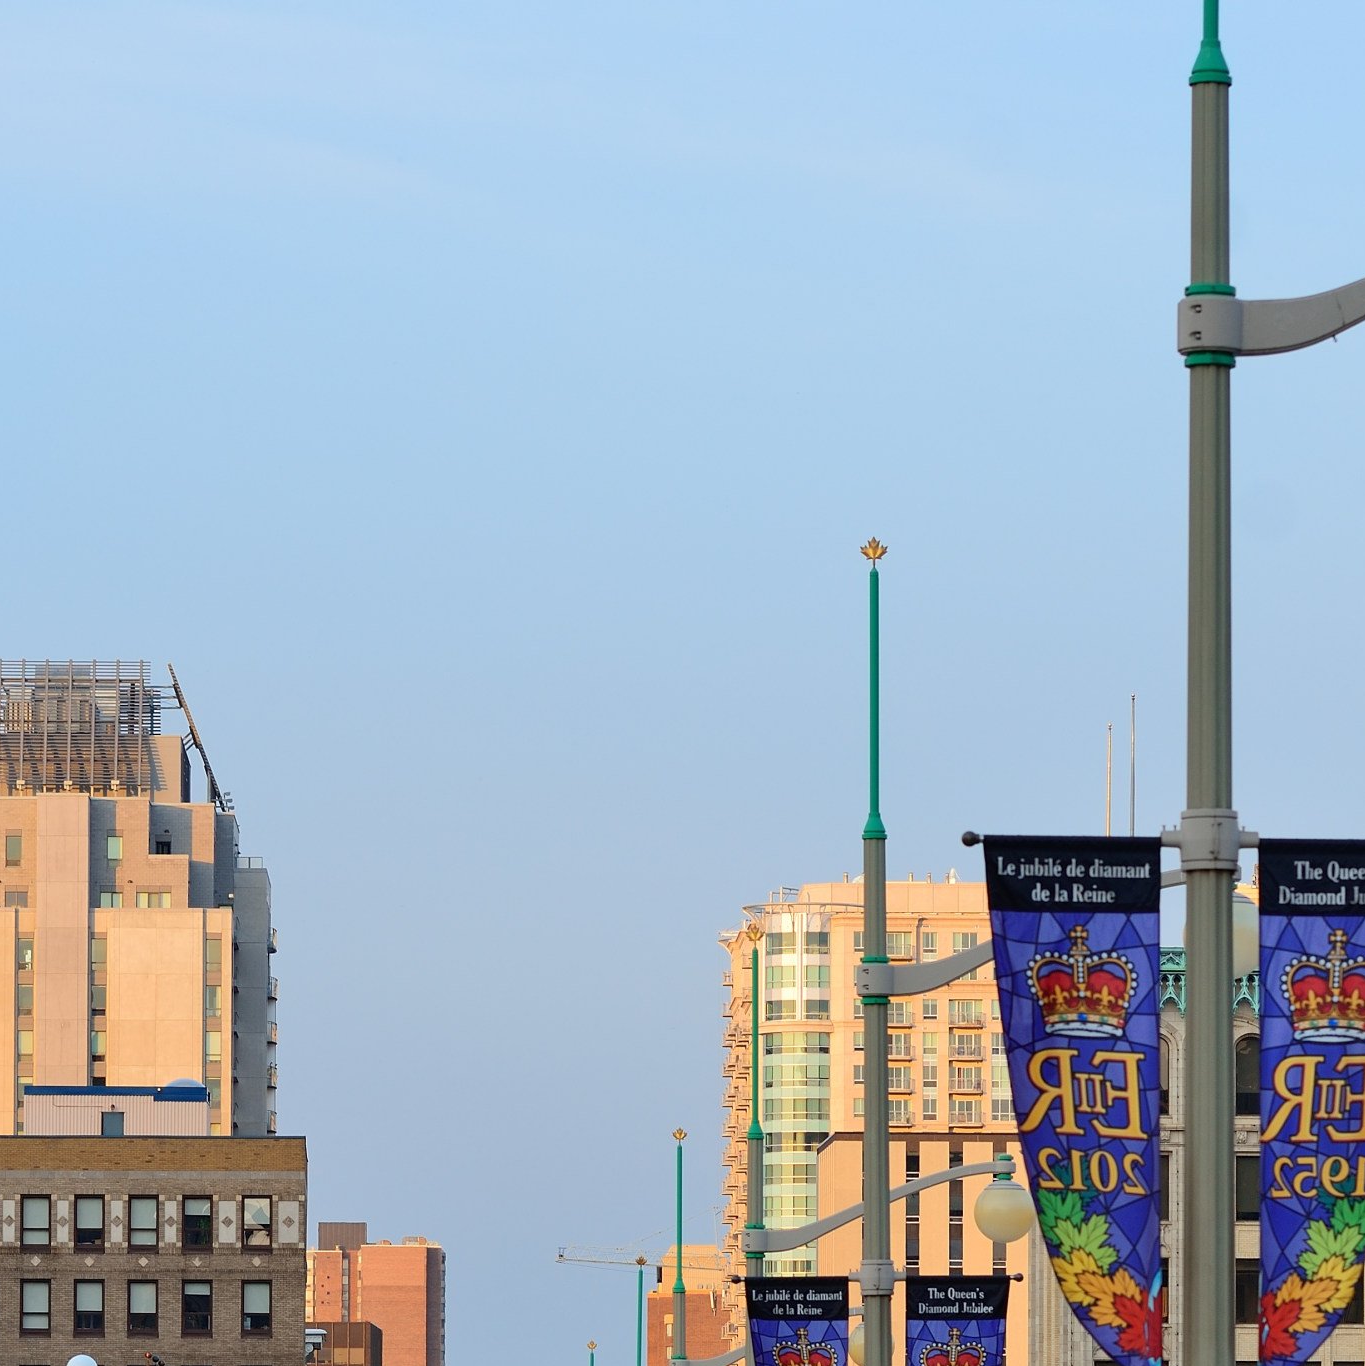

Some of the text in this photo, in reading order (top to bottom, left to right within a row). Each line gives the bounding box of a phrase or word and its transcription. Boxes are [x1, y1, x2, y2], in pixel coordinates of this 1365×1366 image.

[997, 856, 1150, 880] Le jubilé de diamant
[1294, 860, 1323, 880] The
[1031, 882, 1116, 903] de la Reine
[1278, 885, 1346, 905] Diamond
[752, 1289, 843, 1303] Le jubilé de diamant
[927, 1287, 985, 1300] The Queen's
[772, 1303, 823, 1315] de la Reine
[918, 1302, 994, 1314] Diamond Jubilee
